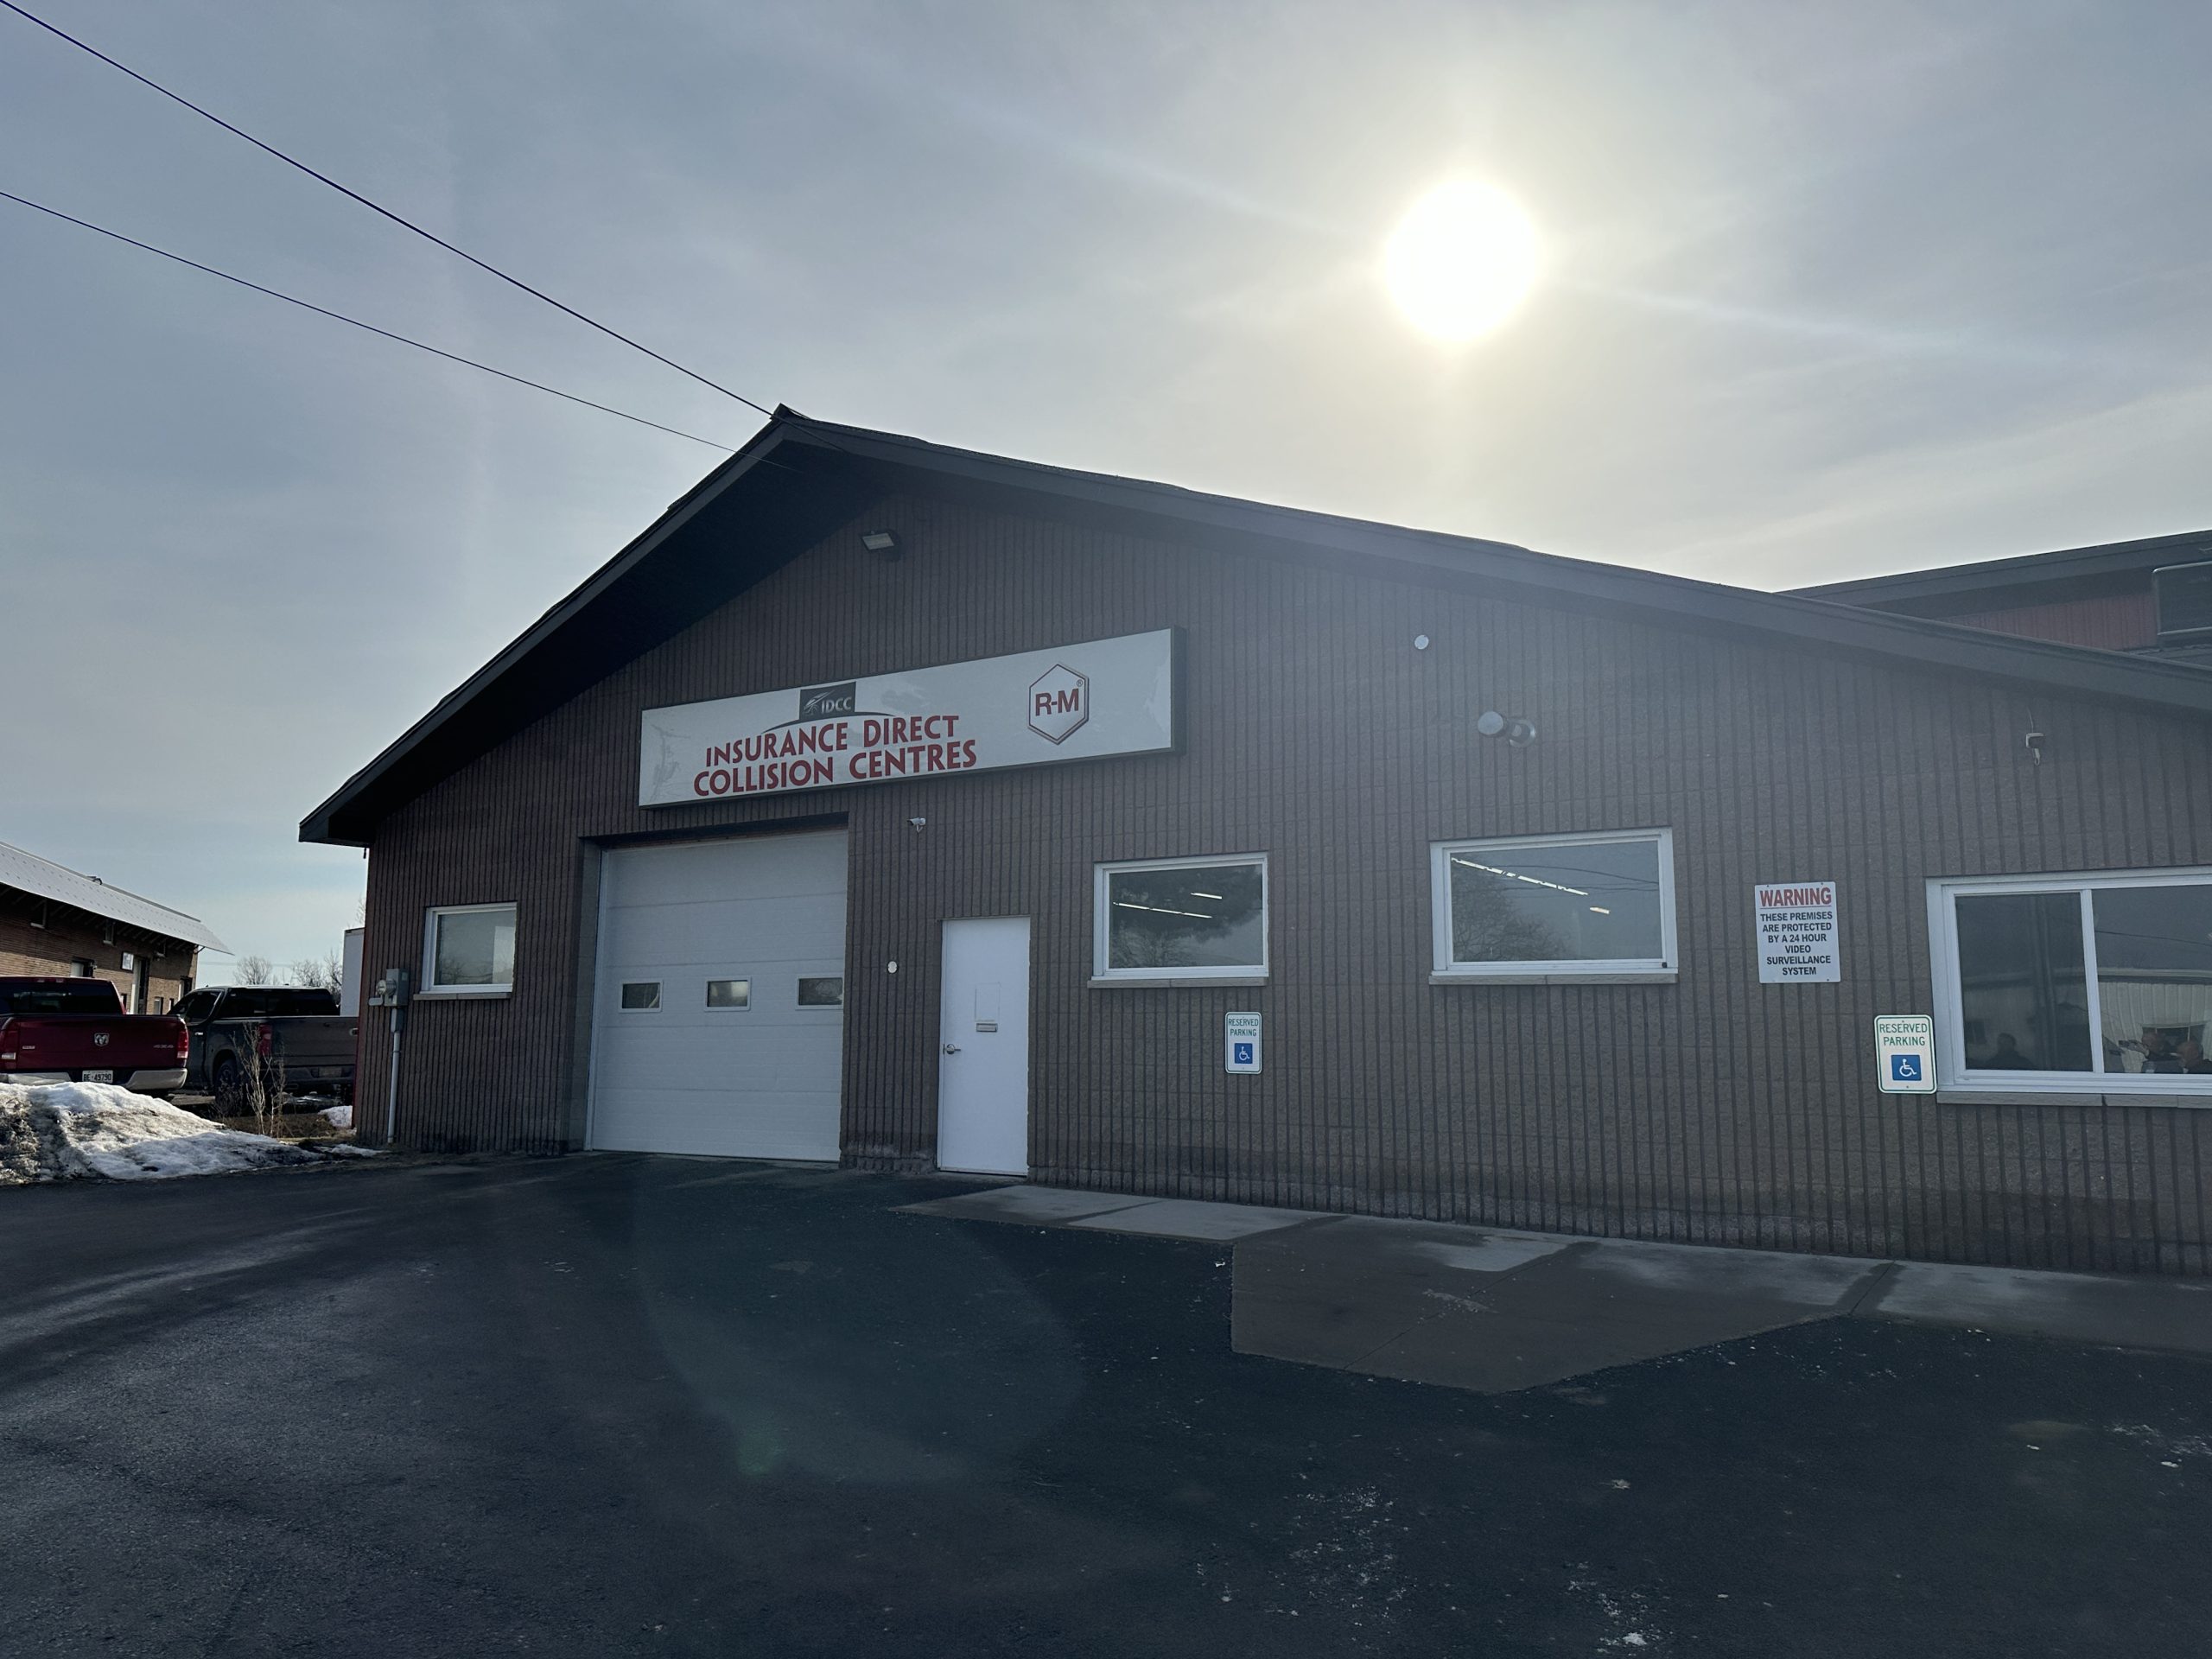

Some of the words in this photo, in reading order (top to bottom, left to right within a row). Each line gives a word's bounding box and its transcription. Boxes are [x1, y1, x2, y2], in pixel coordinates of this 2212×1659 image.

[821, 696, 852, 715] IDCC
[1035, 688, 1079, 716] R-M
[706, 722, 849, 767] INSURANCE
[863, 715, 959, 747] DIRECT
[694, 757, 833, 796] COLLISION
[849, 739, 977, 779] CENTRES
[1759, 887, 1832, 907] WARNING
[1760, 912, 1788, 922] THESE
[1789, 911, 1833, 921] PREMISES
[1781, 922, 1832, 932] PROTECTED
[1789, 934, 1800, 943] 24
[1802, 933, 1827, 942] HOUR
[1784, 944, 1811, 954] VIDEO
[1766, 955, 1831, 965] SURVEILLANCE
[1782, 967, 1816, 976] SYSTEM
[1230, 1028, 1257, 1037] PARKING
[1879, 1023, 1928, 1033] RESERVED
[1883, 1036, 1925, 1046] PARKING
